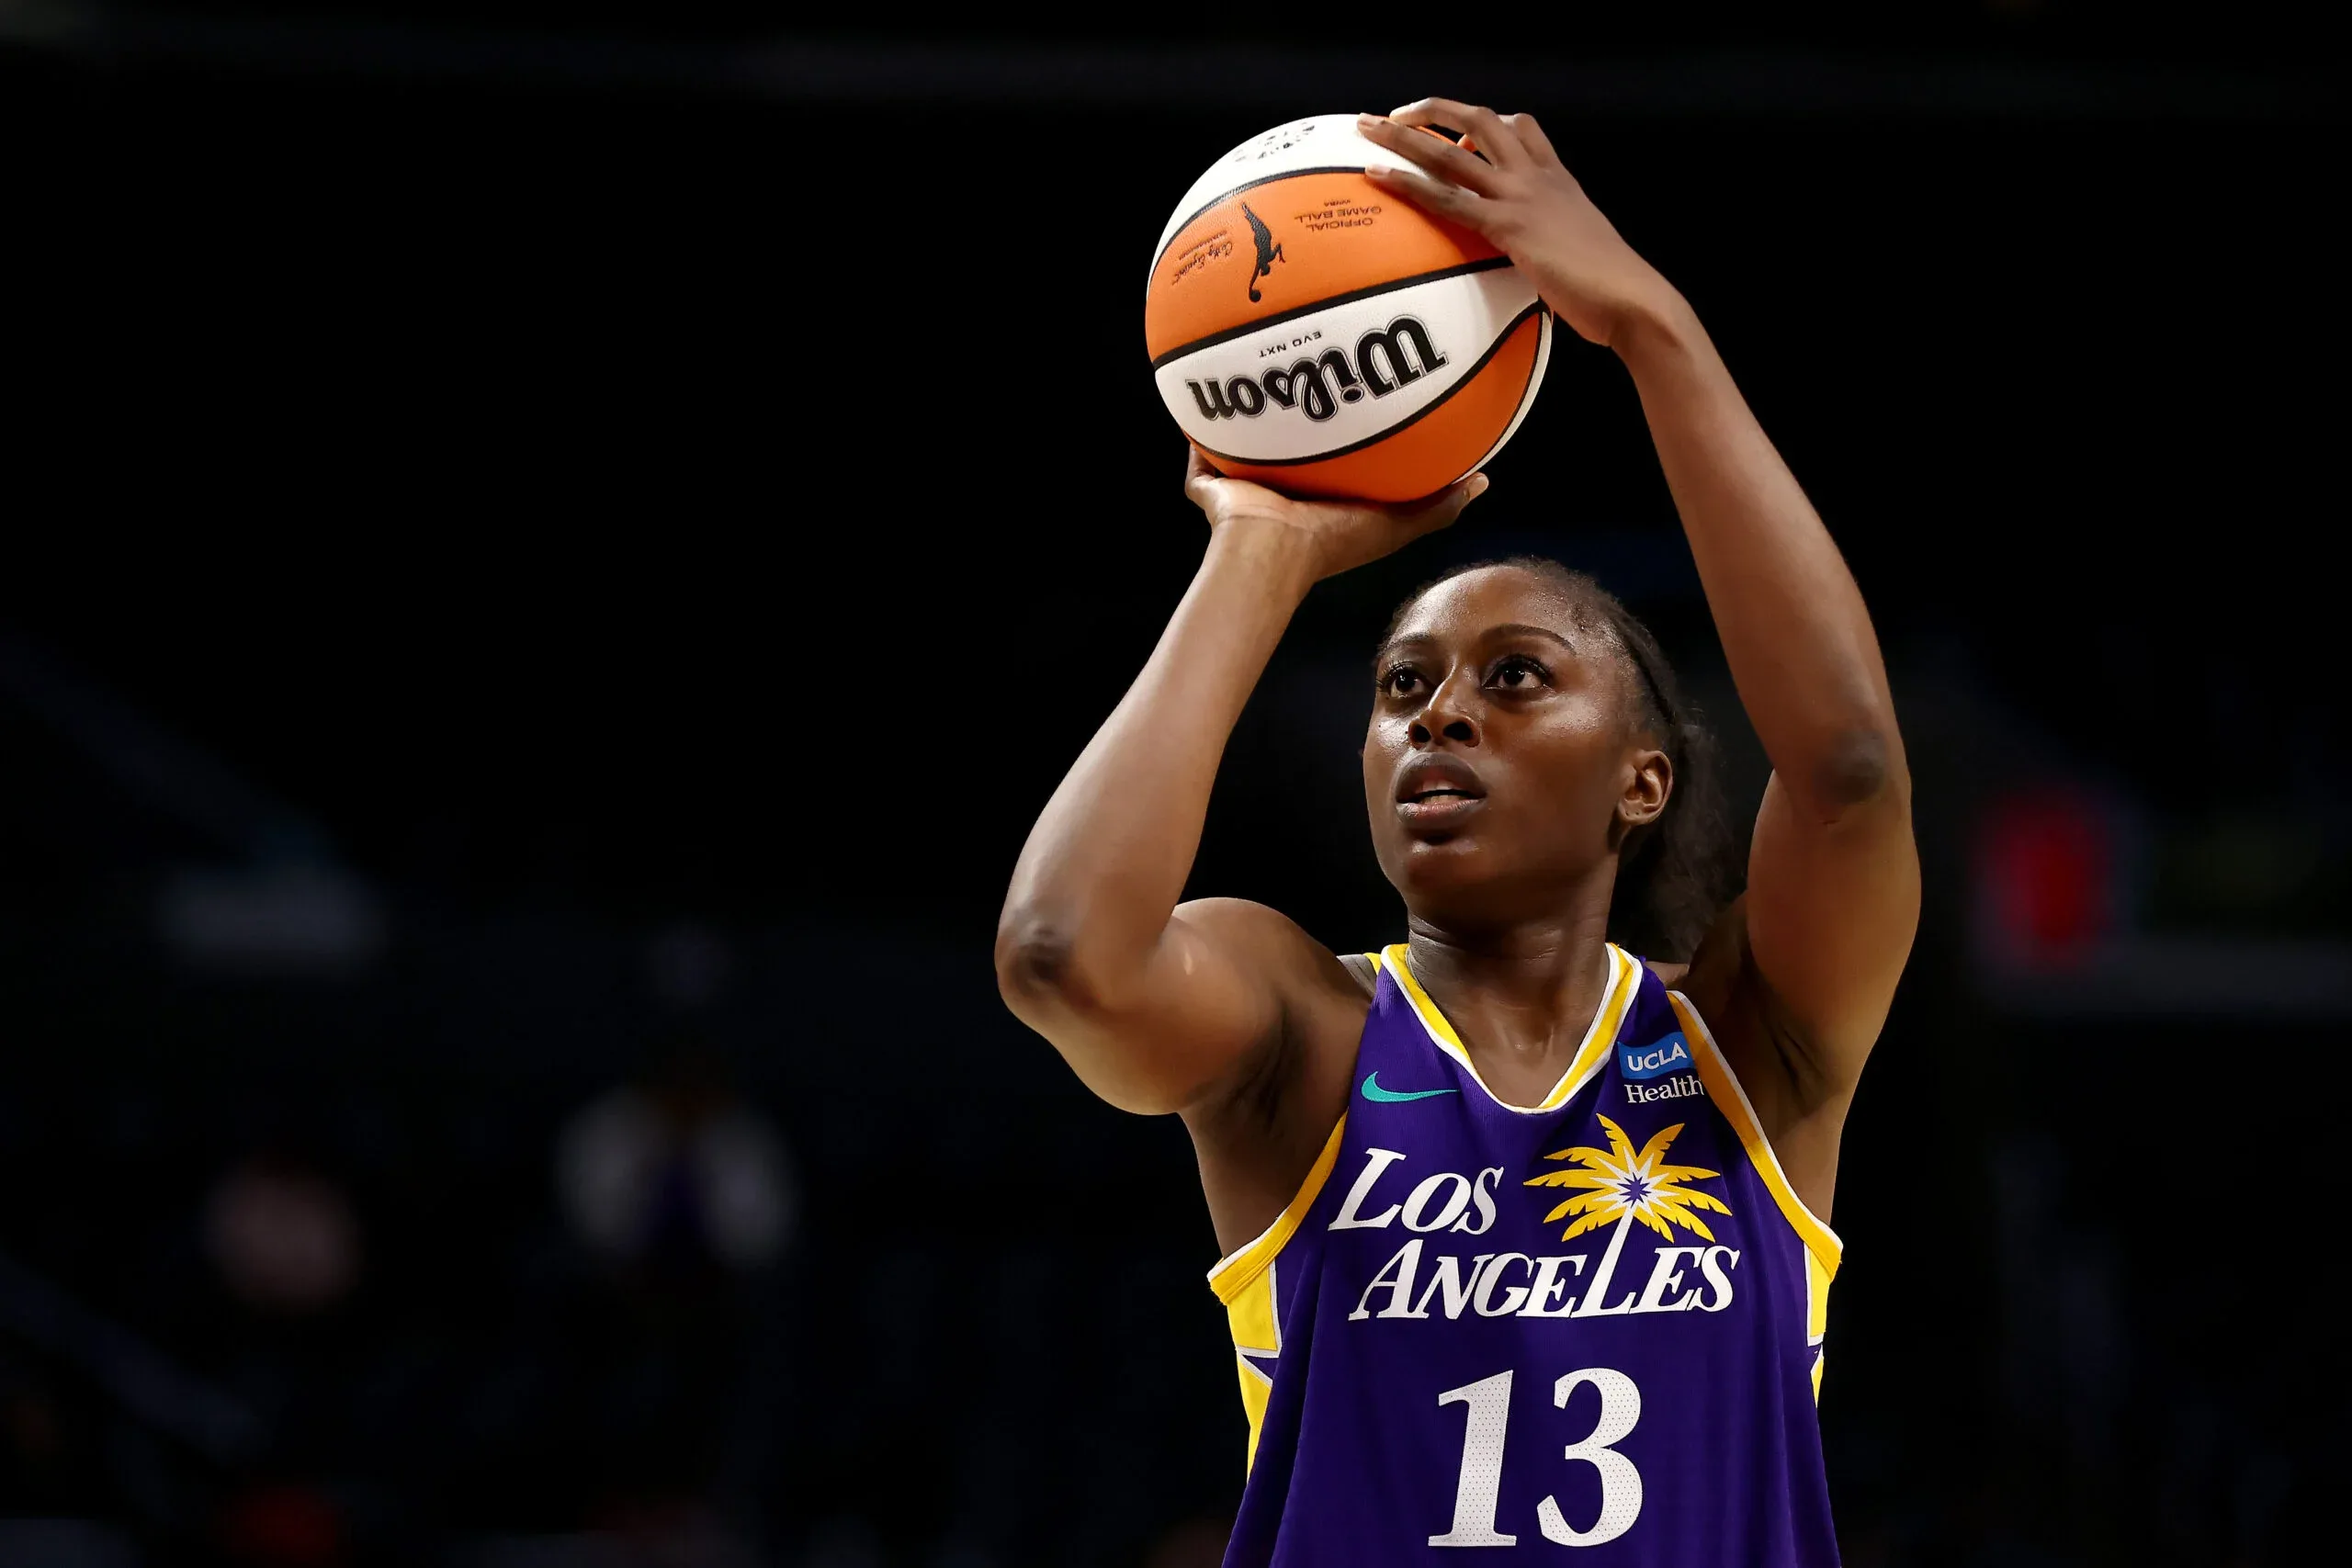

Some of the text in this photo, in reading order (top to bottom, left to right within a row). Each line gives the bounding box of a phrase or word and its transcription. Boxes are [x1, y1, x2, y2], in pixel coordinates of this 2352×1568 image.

[1295, 206, 1382, 223] GAME BALL
[1306, 217, 1374, 232] OFFICIAL
[1260, 331, 1322, 358] EVO NXT
[1185, 313, 1450, 423] Wilson
[1627, 1042, 1688, 1072] UCLA
[1623, 1075, 1704, 1103] Health
[1328, 1147, 1504, 1235] LOS
[1348, 1236, 1741, 1322] ANGELES
[1428, 1367, 1643, 1547] 13
